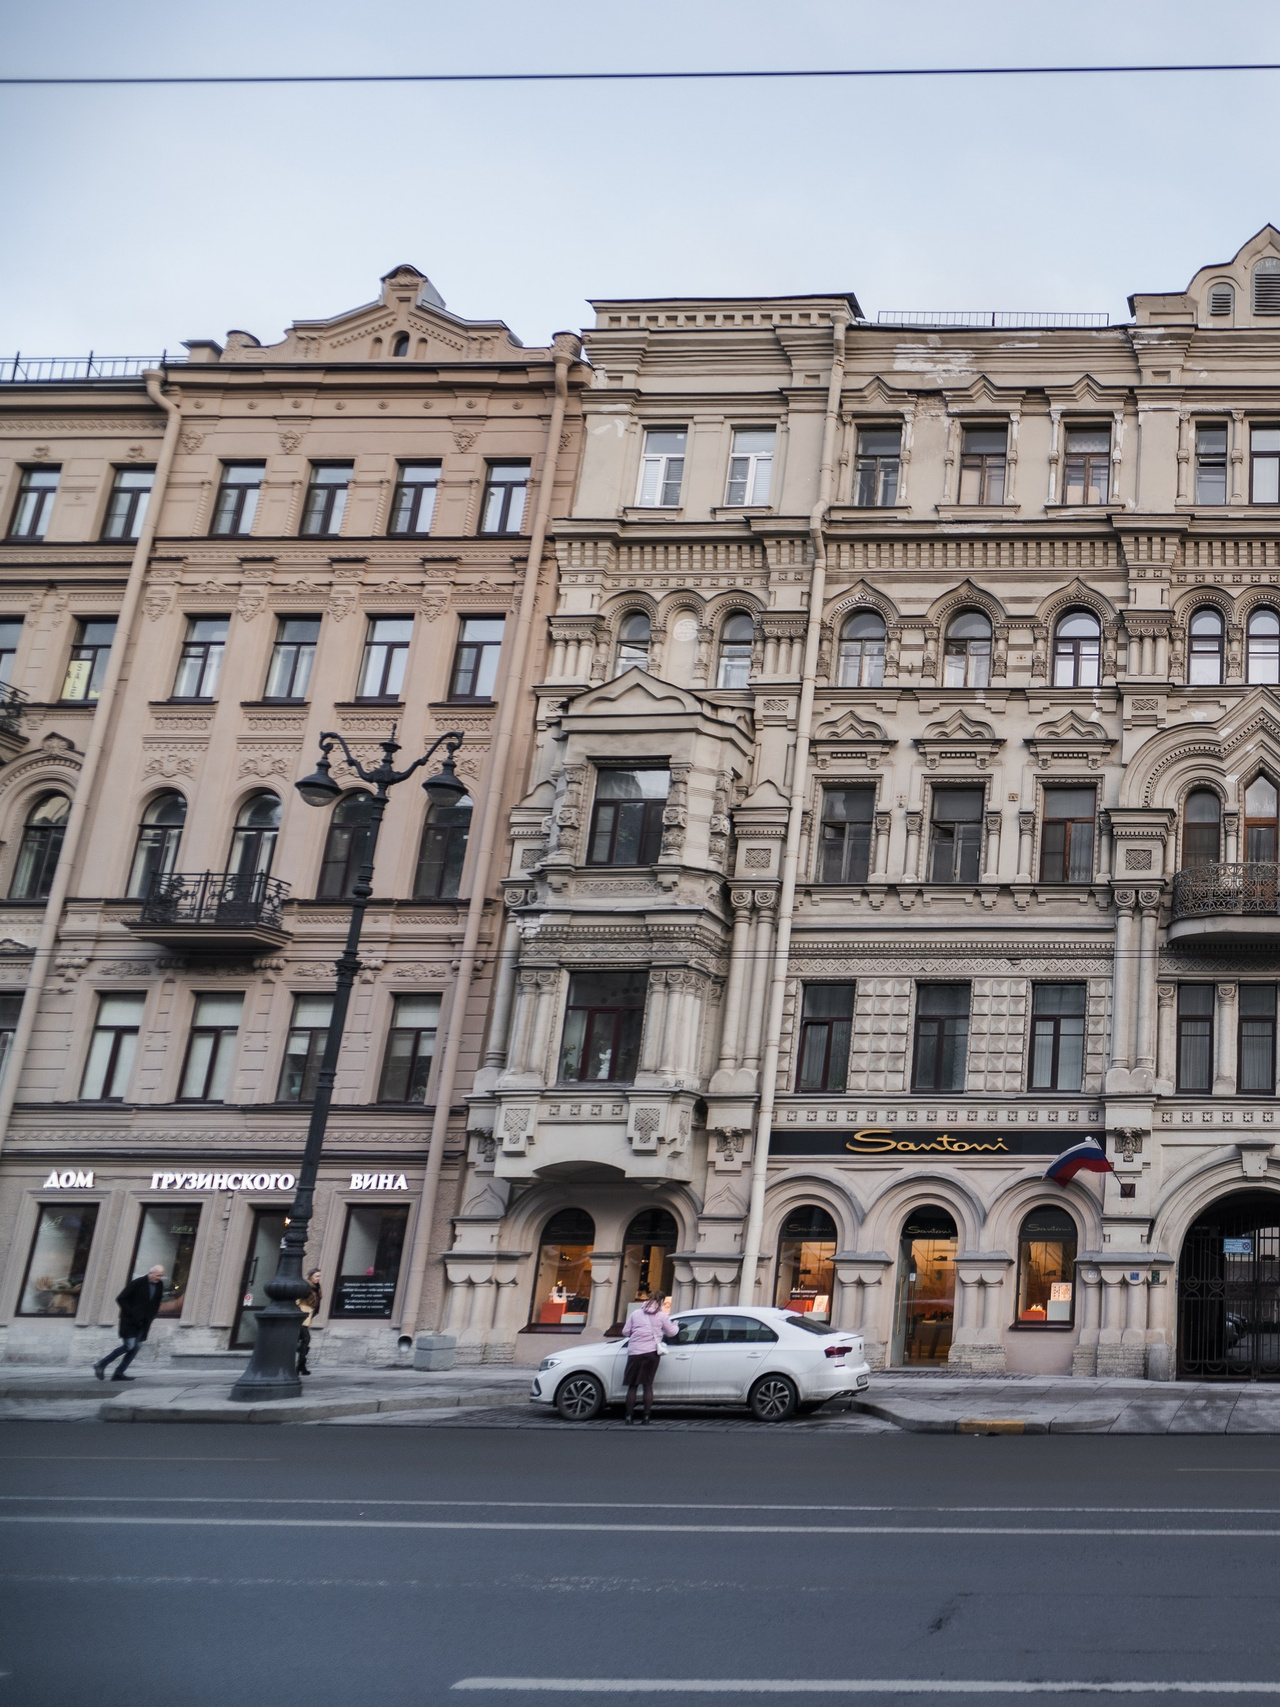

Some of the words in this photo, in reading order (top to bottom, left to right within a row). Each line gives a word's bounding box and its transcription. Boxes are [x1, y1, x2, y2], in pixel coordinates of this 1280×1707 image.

[70, 663, 83, 697] SALE
[845, 1129, 1009, 1153] Santoni
[43, 1170, 95, 1189] ДОМ
[150, 1172, 296, 1191] ГРУЗИНСКОГО
[349, 1173, 409, 1190] ВИНА
[906, 1225, 952, 1234] Santoni
[1025, 1223, 1072, 1232] Santoni
